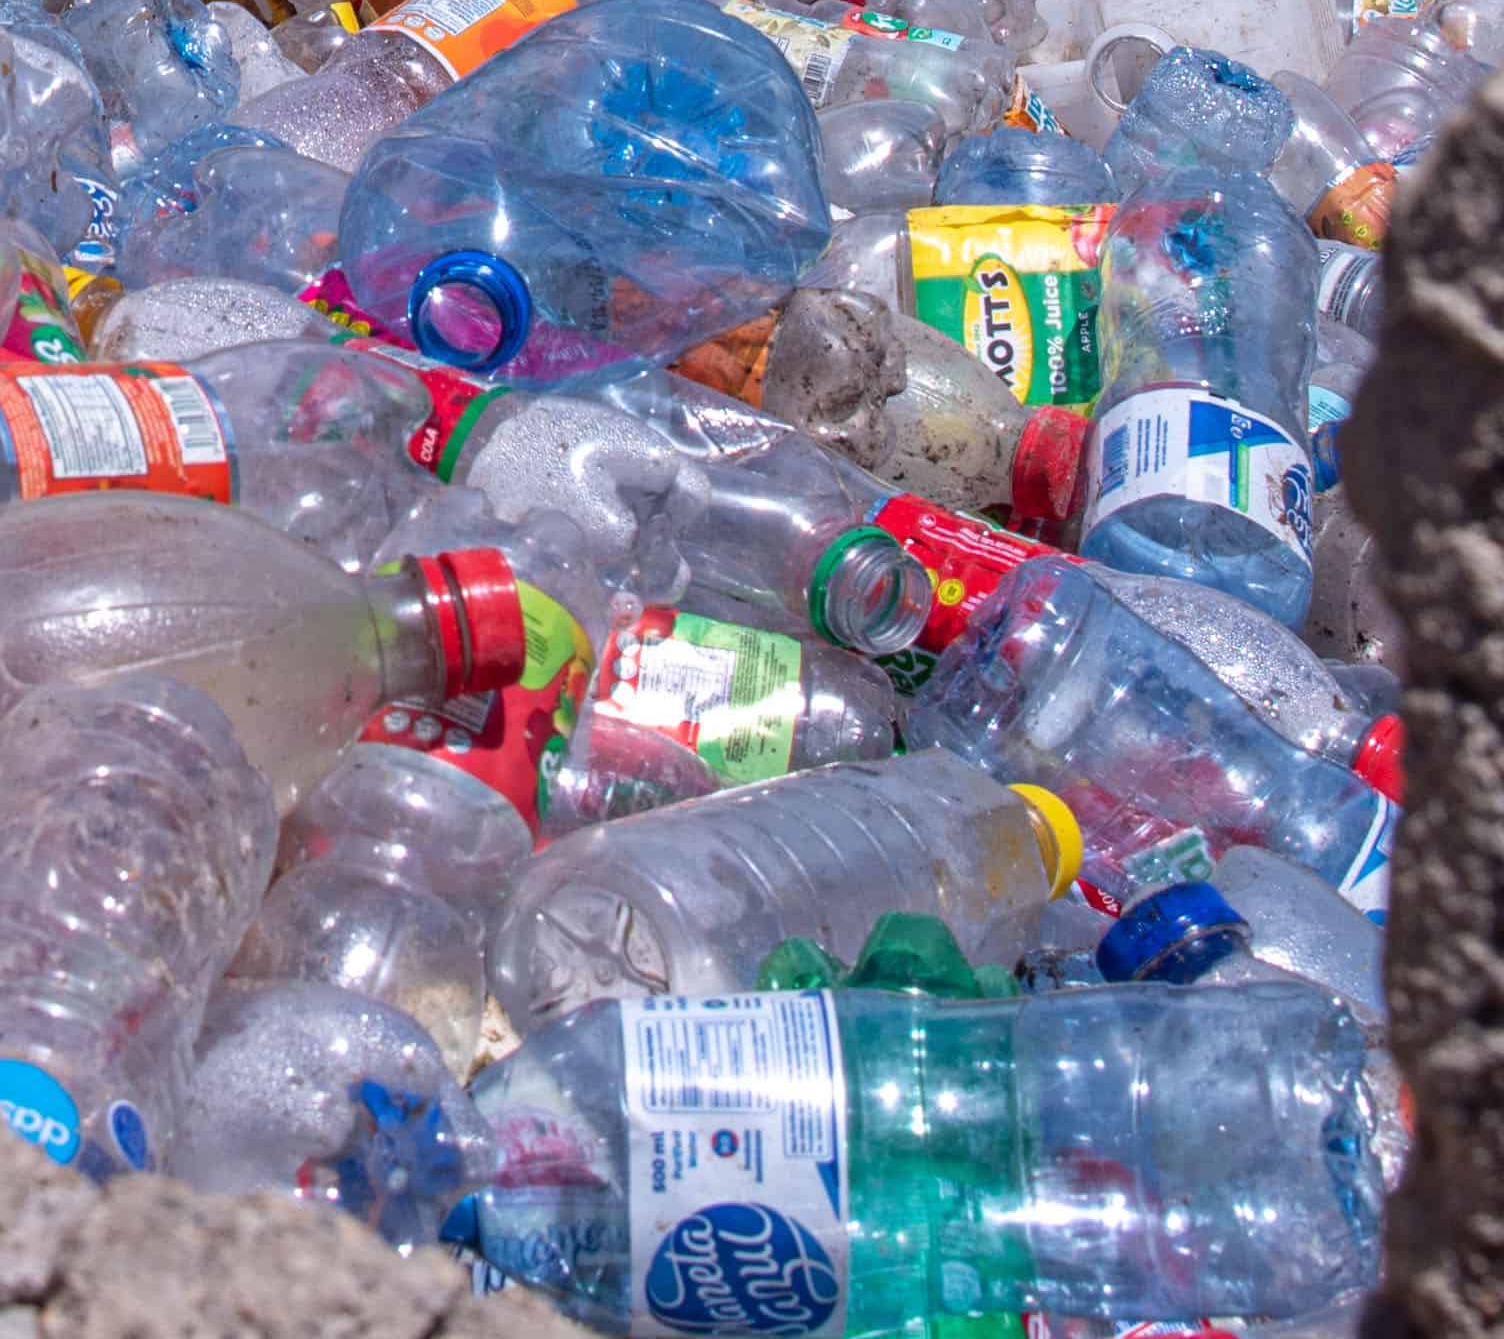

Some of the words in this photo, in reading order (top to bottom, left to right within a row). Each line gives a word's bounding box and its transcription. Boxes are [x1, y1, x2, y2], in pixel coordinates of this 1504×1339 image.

[1047, 273, 1061, 326] Juice
[1080, 310, 1092, 354] APPLE
[1049, 327, 1064, 397] 100%
[419, 427, 439, 463] COLA
[653, 1157, 667, 1194] 500
